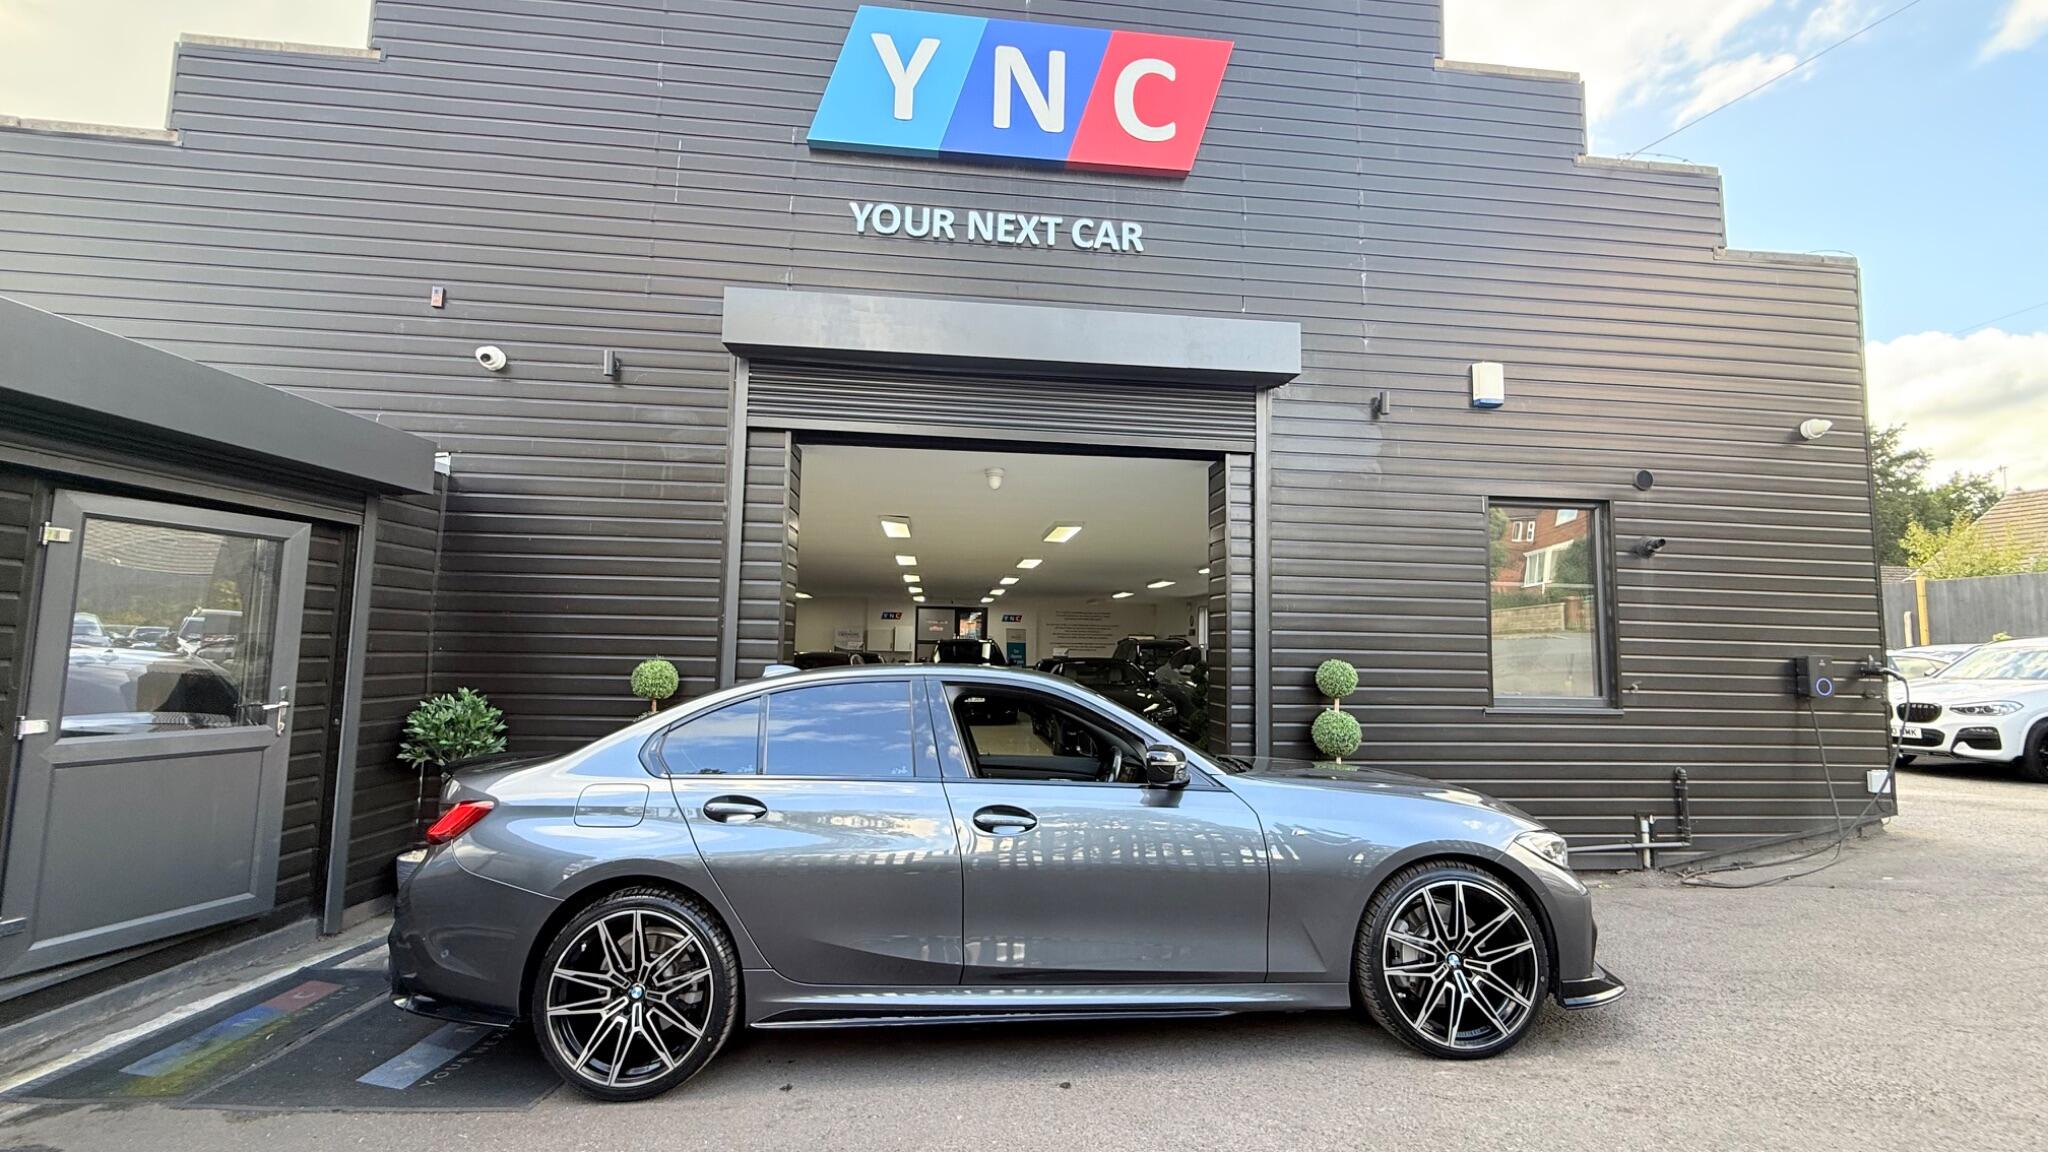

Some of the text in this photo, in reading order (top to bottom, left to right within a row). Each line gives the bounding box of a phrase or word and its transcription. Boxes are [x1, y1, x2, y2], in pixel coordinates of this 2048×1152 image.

[871, 33, 1177, 142] YNC
[849, 202, 1144, 252] YOUR NEXT CAR
[418, 1057, 474, 1087] YOUR
